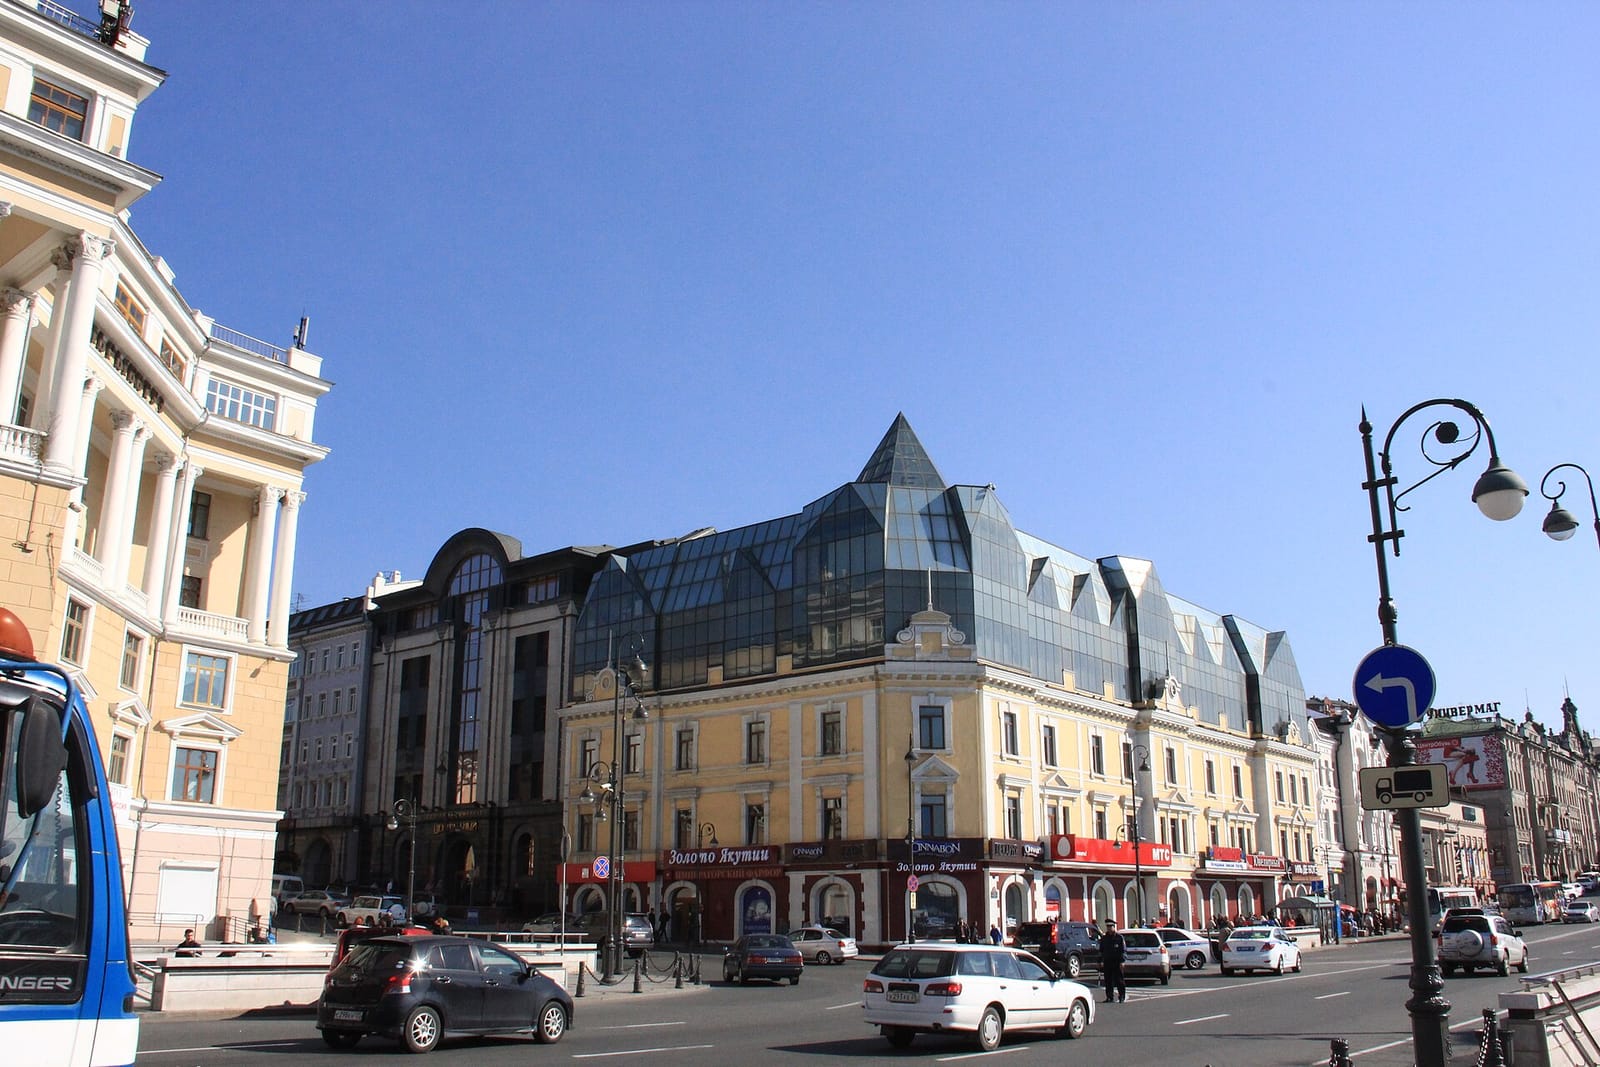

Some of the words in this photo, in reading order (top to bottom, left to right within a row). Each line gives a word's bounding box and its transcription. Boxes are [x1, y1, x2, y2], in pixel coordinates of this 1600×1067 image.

[1427, 702, 1500, 719] УНИВЕРМАГ
[719, 848, 769, 865] Якутии
[1152, 847, 1170, 862] МТС
[938, 862, 977, 872] Якутии
